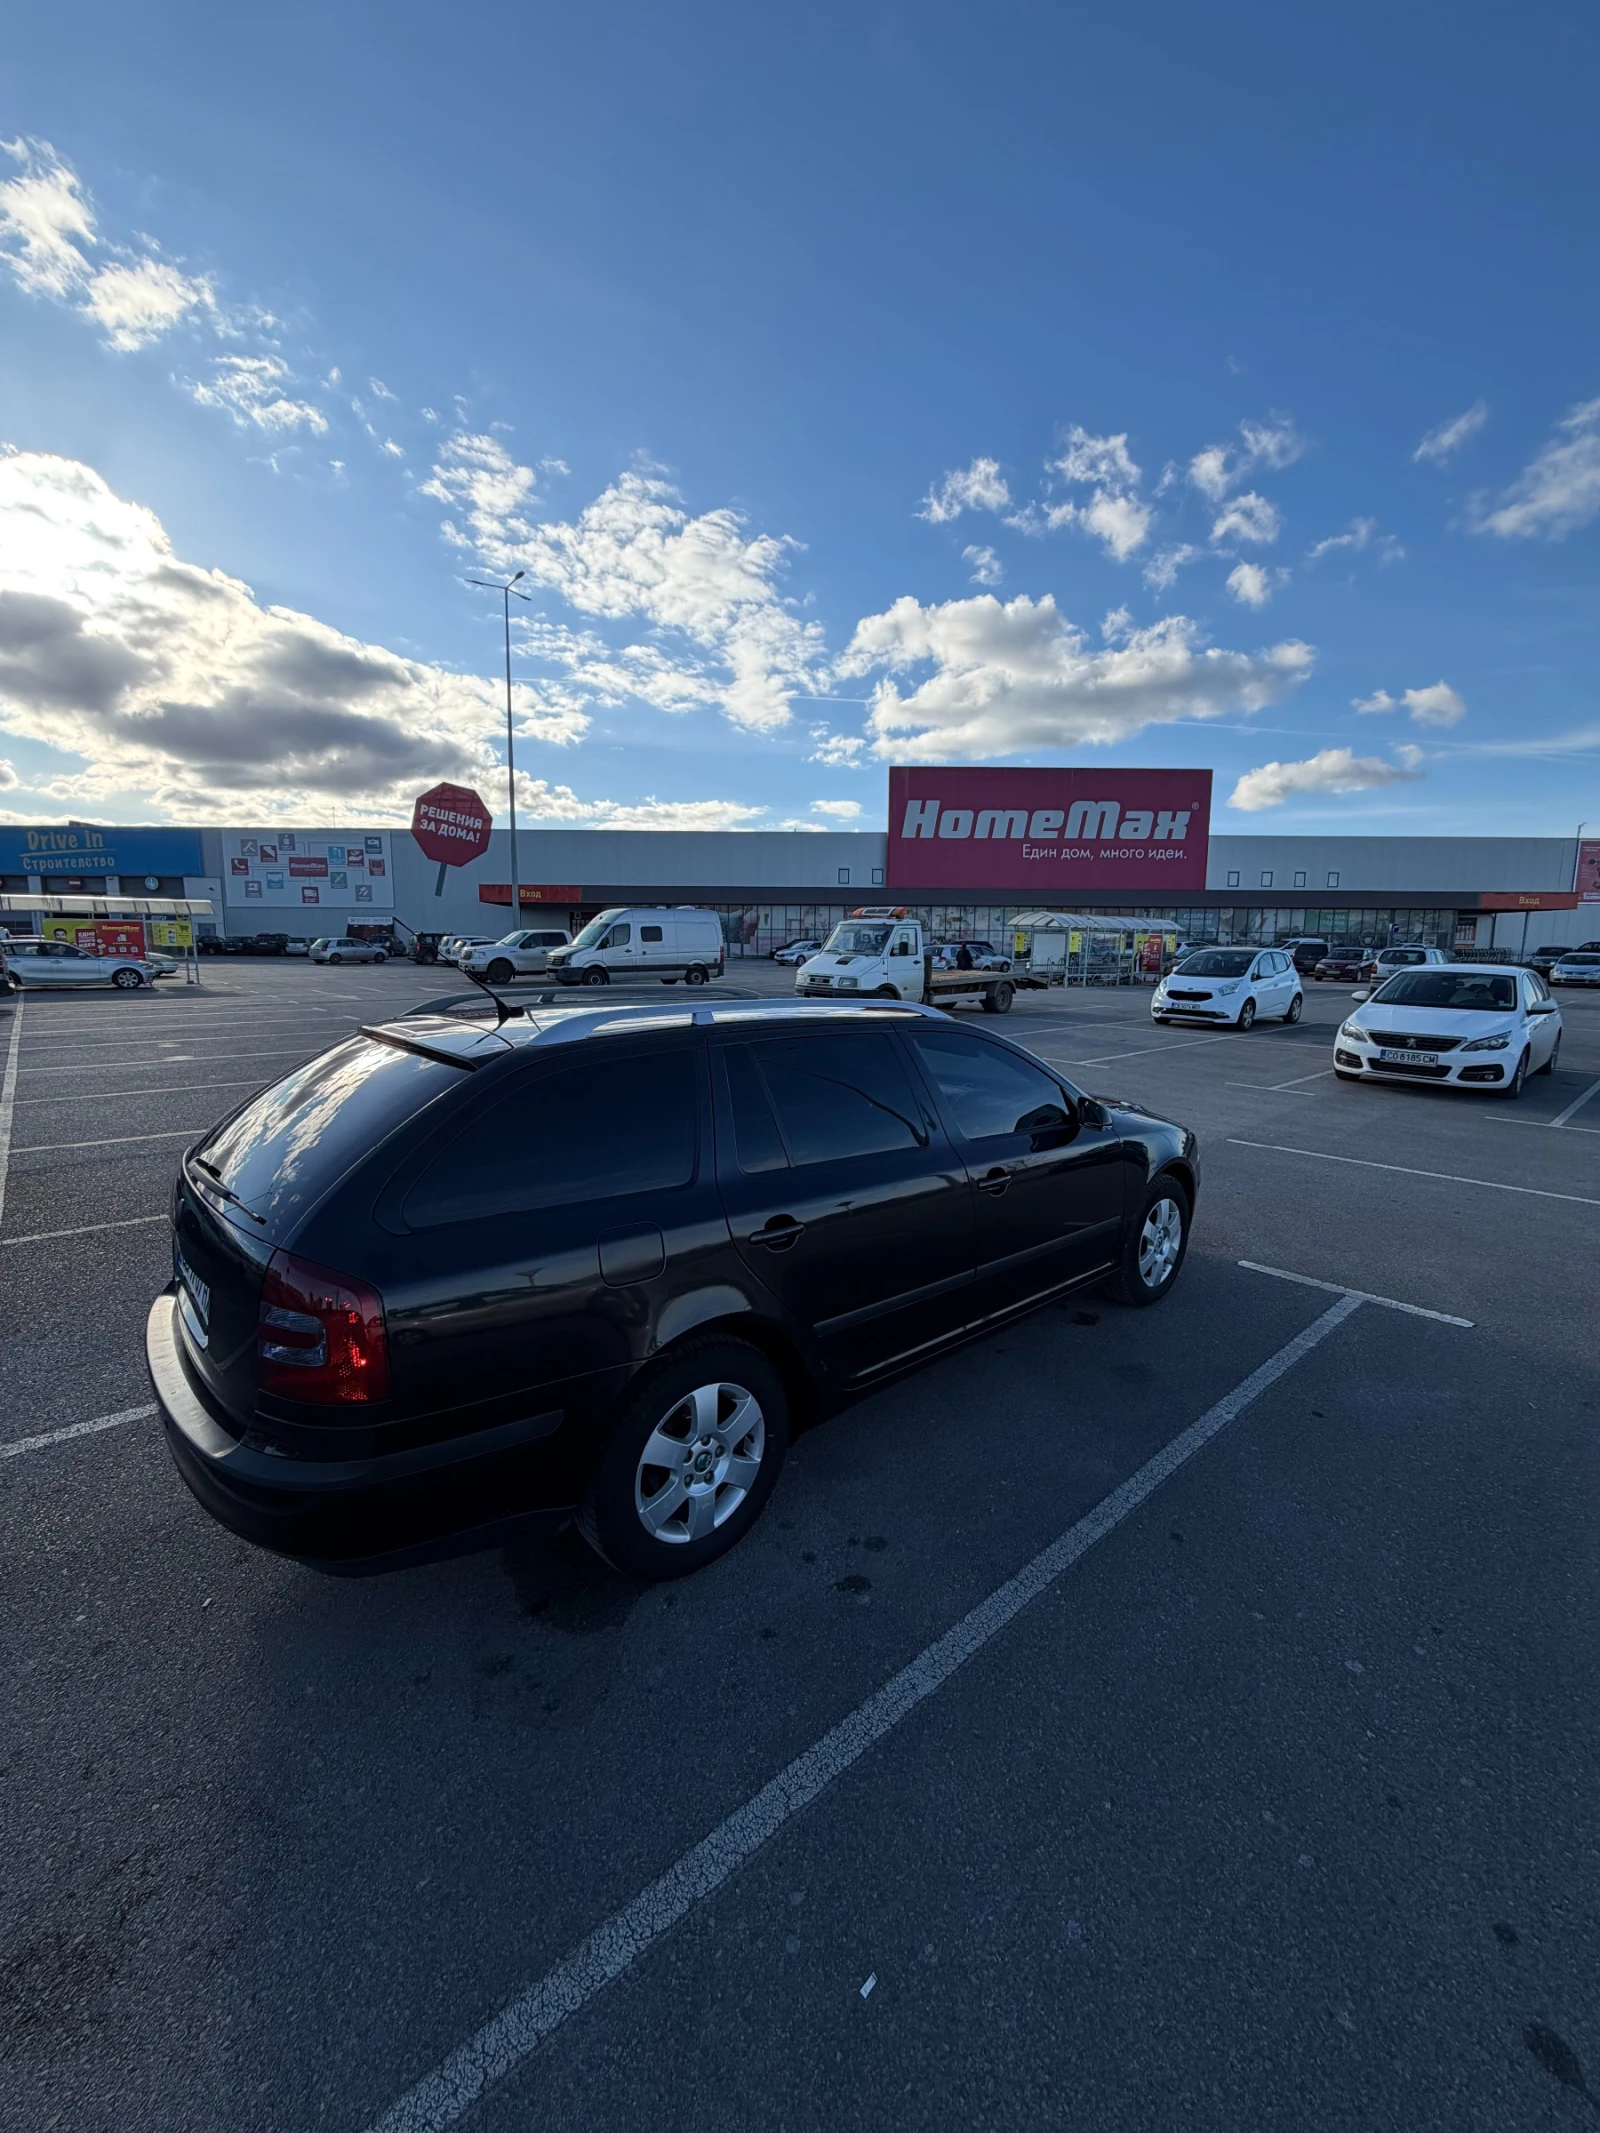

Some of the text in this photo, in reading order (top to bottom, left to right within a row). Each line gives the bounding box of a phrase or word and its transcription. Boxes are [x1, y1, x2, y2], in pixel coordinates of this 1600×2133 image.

[420, 804, 483, 829] РЕШЕНИЯ
[420, 818, 480, 843] ЗА ДОМА!
[27, 830, 104, 850] Drive in
[1022, 844, 1187, 861] Един дом, много идеи.
[22, 856, 115, 872] Строителство
[520, 889, 541, 898] Вход
[1519, 896, 1540, 905] Вход
[1387, 1052, 1435, 1064] CO 8185 CM
